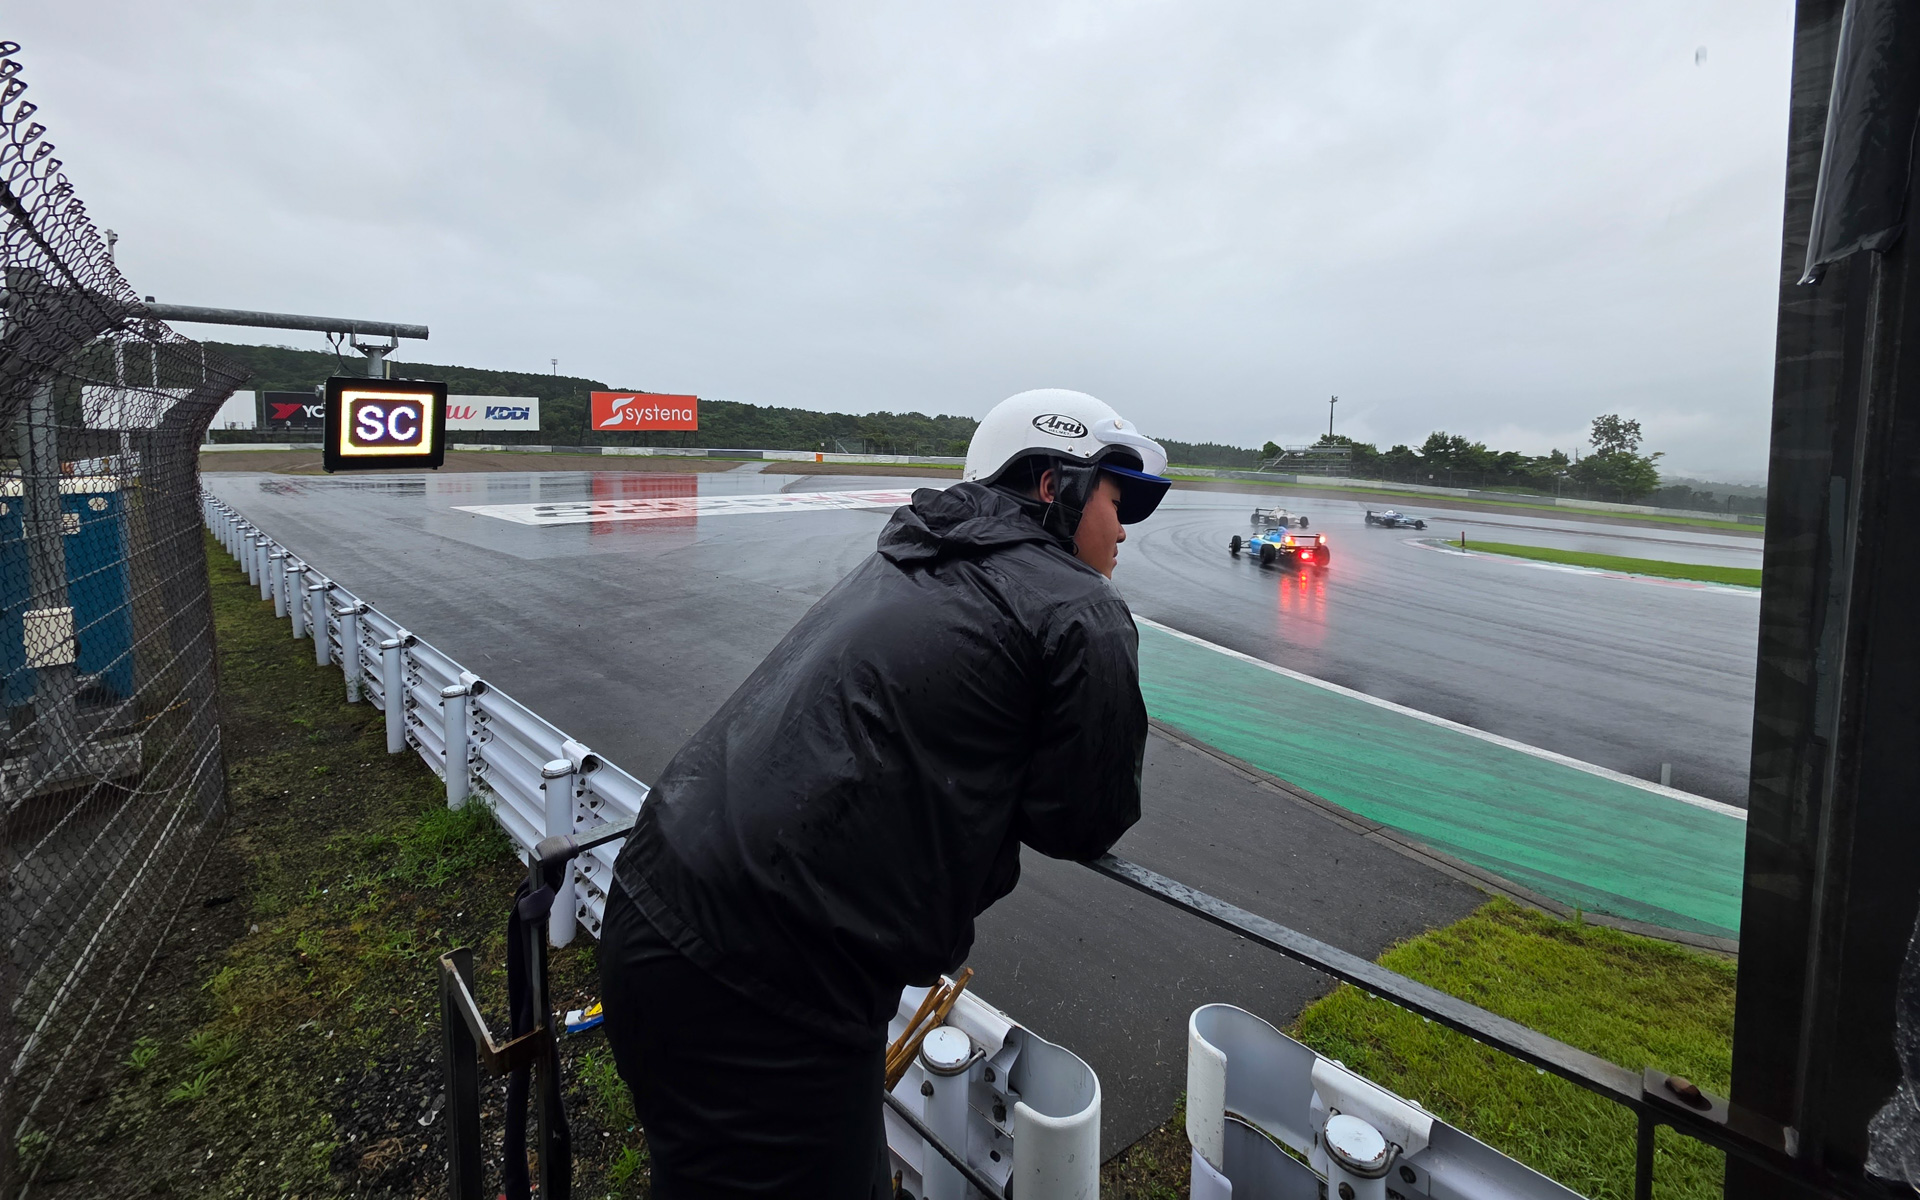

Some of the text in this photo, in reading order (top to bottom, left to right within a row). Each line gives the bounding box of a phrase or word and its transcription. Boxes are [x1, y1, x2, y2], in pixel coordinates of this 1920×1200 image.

[485, 406, 530, 420] KDDI
[626, 404, 693, 425] systena
[356, 405, 417, 441] SC
[1036, 416, 1082, 434] Arai
